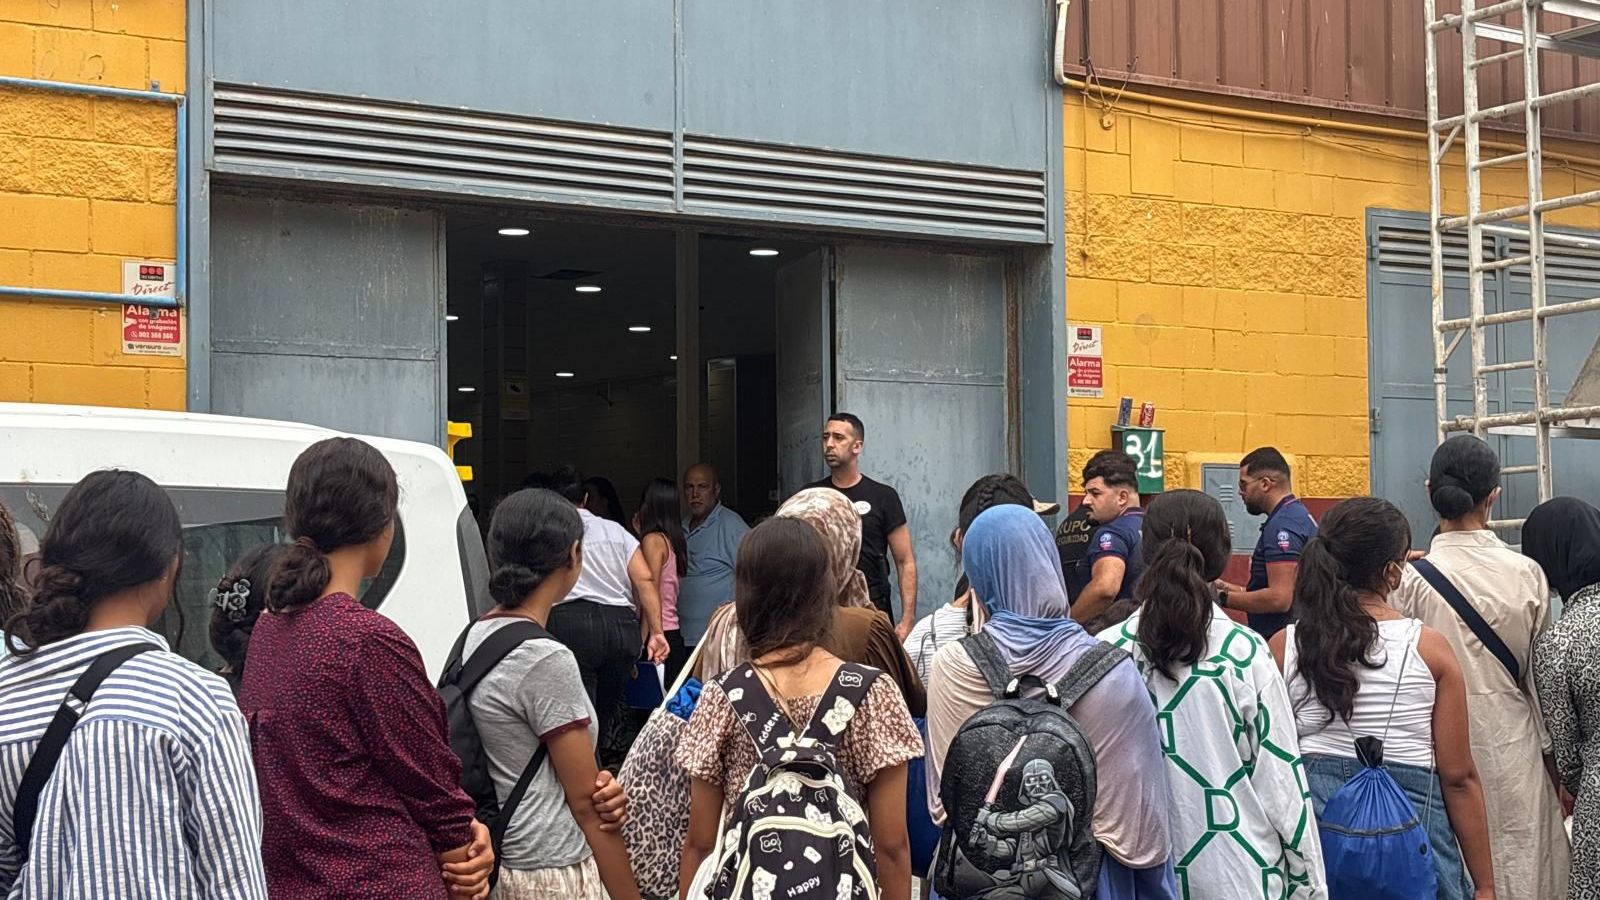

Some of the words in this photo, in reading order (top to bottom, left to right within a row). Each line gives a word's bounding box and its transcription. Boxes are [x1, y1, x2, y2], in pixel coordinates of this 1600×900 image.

[132, 281, 173, 295] Direct
[127, 305, 177, 317] Alama
[1070, 358, 1100, 367] Alarma
[1126, 431, 1162, 478] 31
[759, 712, 780, 744] Happy
[787, 876, 820, 897] Happy
